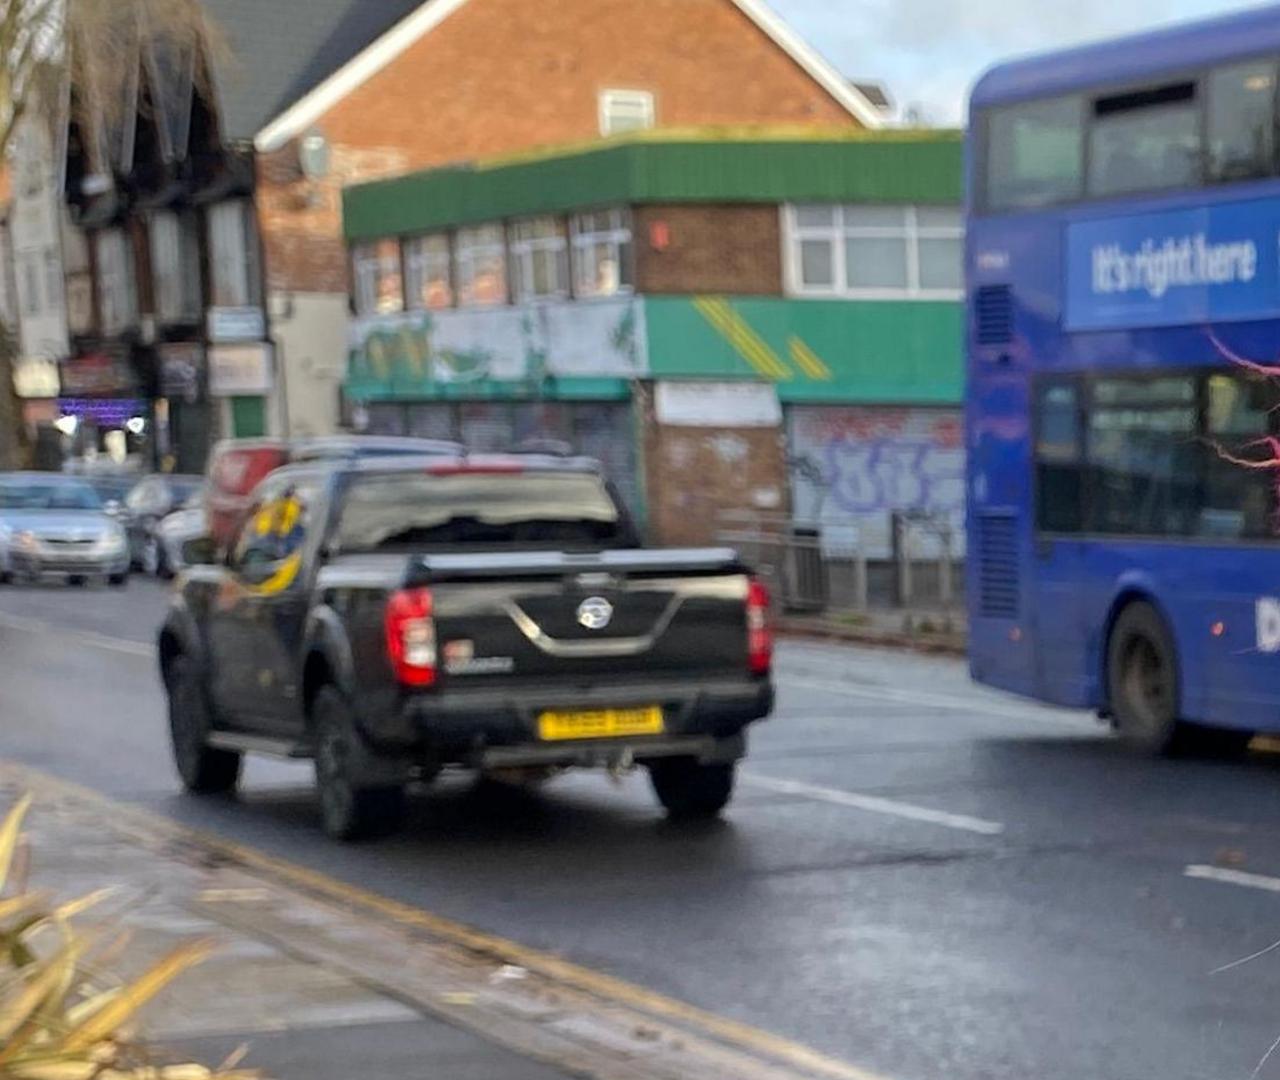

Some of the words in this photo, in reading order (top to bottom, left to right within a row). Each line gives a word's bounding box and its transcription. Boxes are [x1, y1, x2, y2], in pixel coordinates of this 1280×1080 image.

[1092, 247, 1129, 293] It's
[1135, 237, 1197, 297] right
[1198, 233, 1257, 284] here
